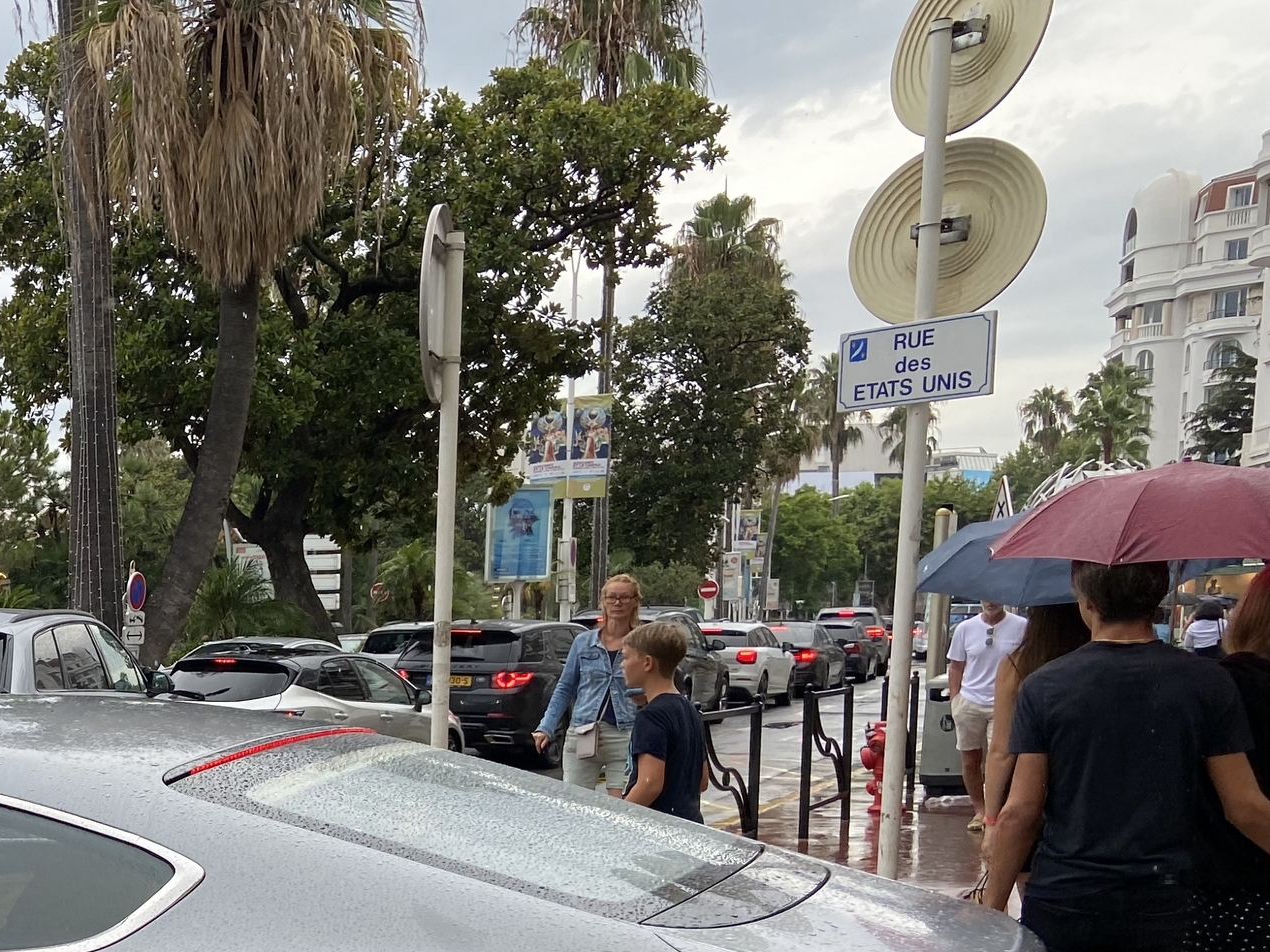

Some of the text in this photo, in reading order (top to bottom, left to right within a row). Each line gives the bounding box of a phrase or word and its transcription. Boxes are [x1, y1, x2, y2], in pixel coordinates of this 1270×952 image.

[894, 329, 935, 350] RUE
[895, 356, 931, 373] des
[854, 371, 972, 401] ETATS UNIS
